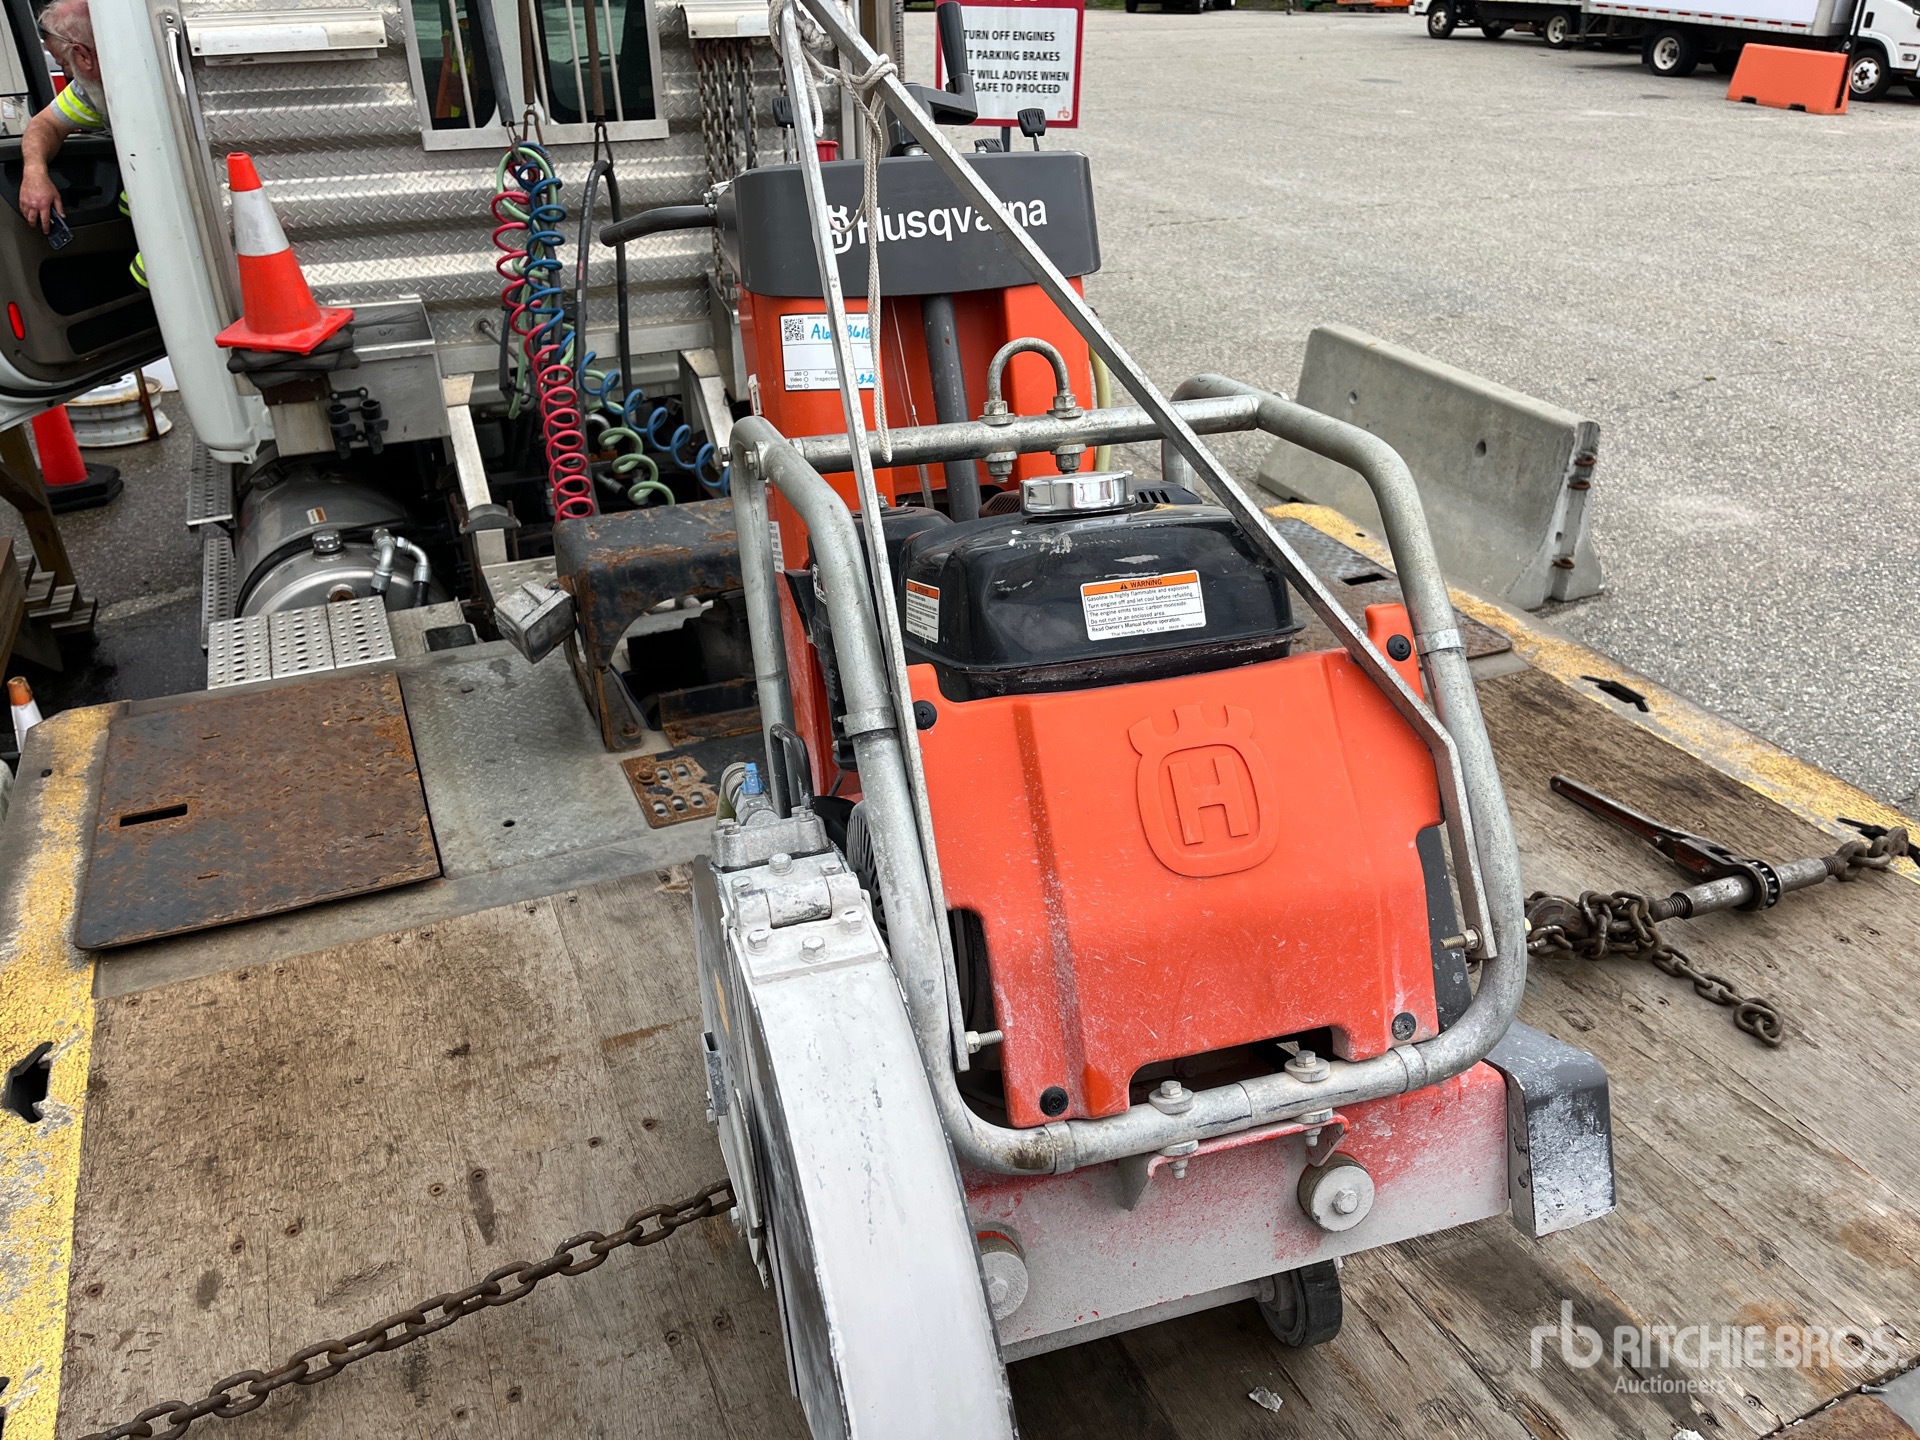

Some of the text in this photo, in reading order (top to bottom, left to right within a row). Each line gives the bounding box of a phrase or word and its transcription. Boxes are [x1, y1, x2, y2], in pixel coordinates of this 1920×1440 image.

[964, 30, 1055, 41] TURN OFF ENGINES
[976, 50, 1020, 61] PARKING
[1022, 51, 1060, 62] BRAKES
[977, 70, 1000, 80] WILL
[1002, 70, 1038, 80] ADVISE
[1040, 71, 1069, 81] WHEN
[975, 82, 1060, 93] SAFE TO PROCEED
[856, 199, 1047, 244] Husqvana
[1130, 579, 1162, 588] WARNING
[1087, 594, 1108, 602] Gasoline
[1131, 588, 1156, 596] flammable
